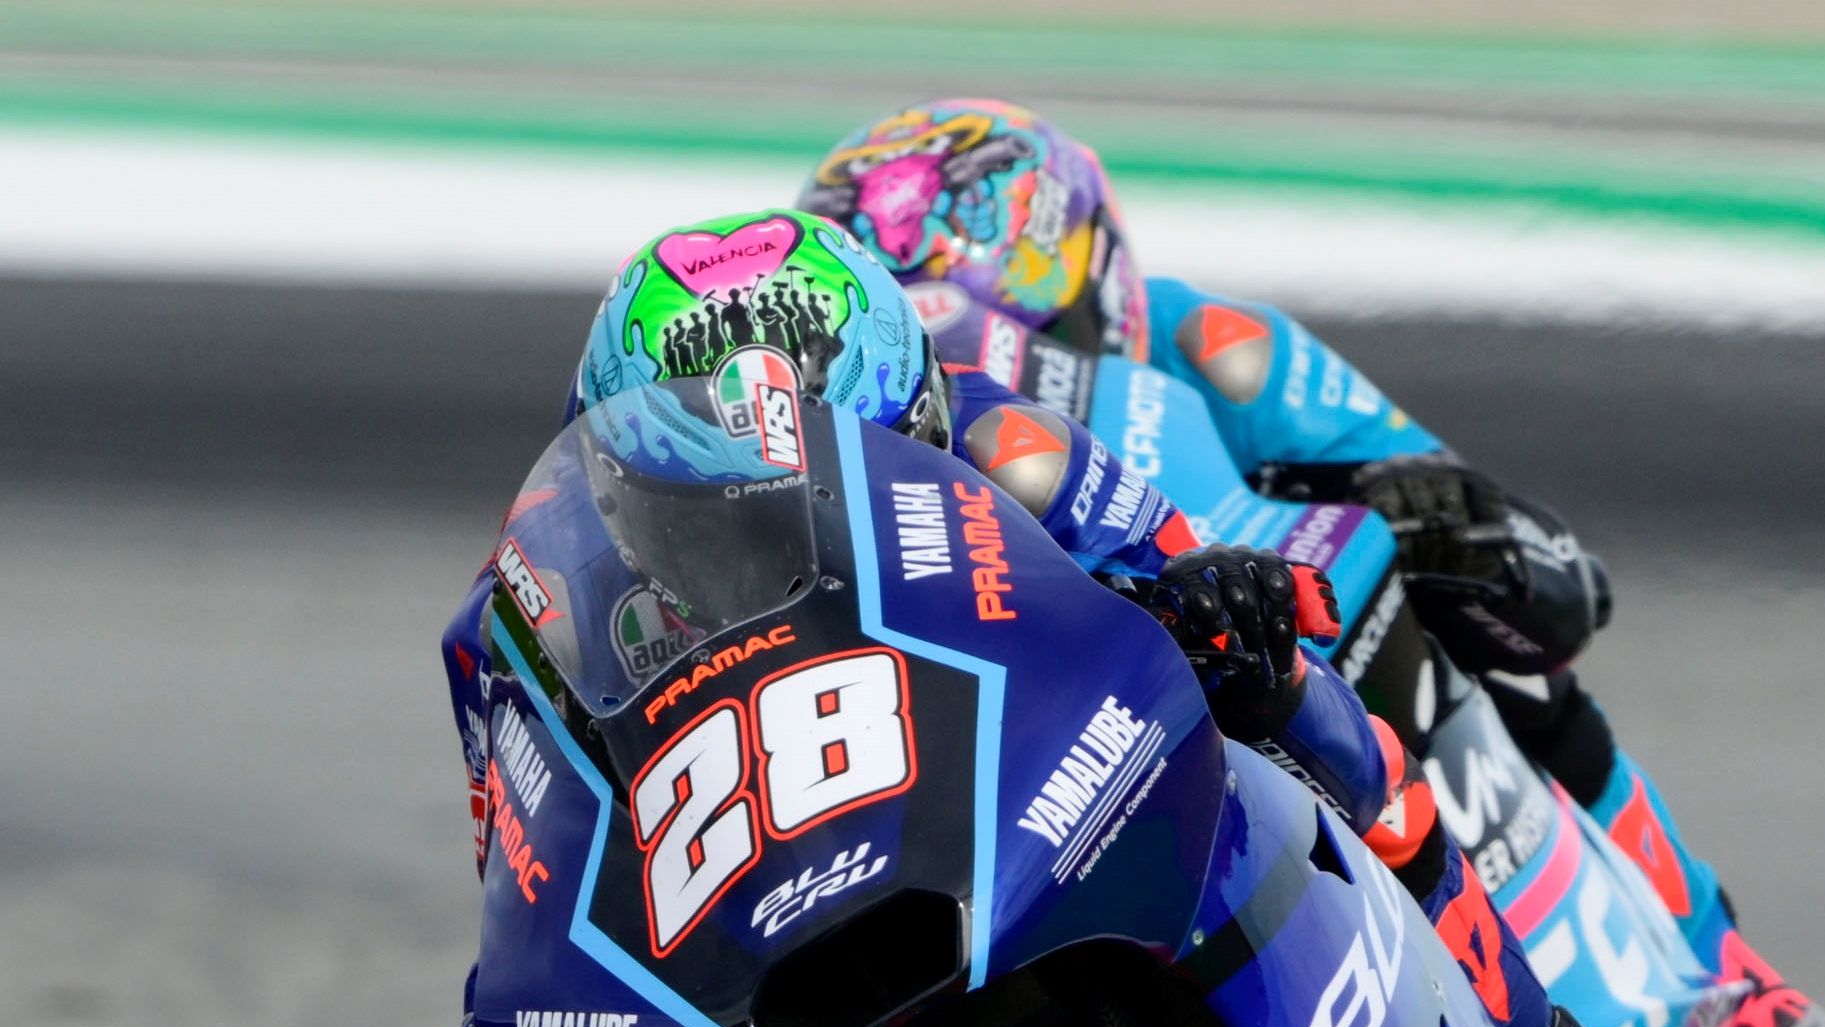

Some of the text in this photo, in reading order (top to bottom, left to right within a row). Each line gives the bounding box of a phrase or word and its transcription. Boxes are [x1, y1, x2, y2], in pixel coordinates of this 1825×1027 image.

[681, 240, 778, 276] VALENCIA
[758, 385, 801, 466] WRS
[498, 544, 550, 620] WRS
[891, 482, 953, 581] YAMAHA
[953, 481, 1017, 621] PRAMAC
[644, 624, 797, 725] PRAMAC
[497, 697, 552, 818] YAMAHA
[630, 647, 917, 958] 28
[1017, 695, 1147, 848] YAMALUBE
[488, 757, 549, 904] PRAMAC
[1077, 756, 1168, 882] Liquid Engine Component
[750, 842, 871, 927] BLU
[764, 855, 888, 938] CRU
